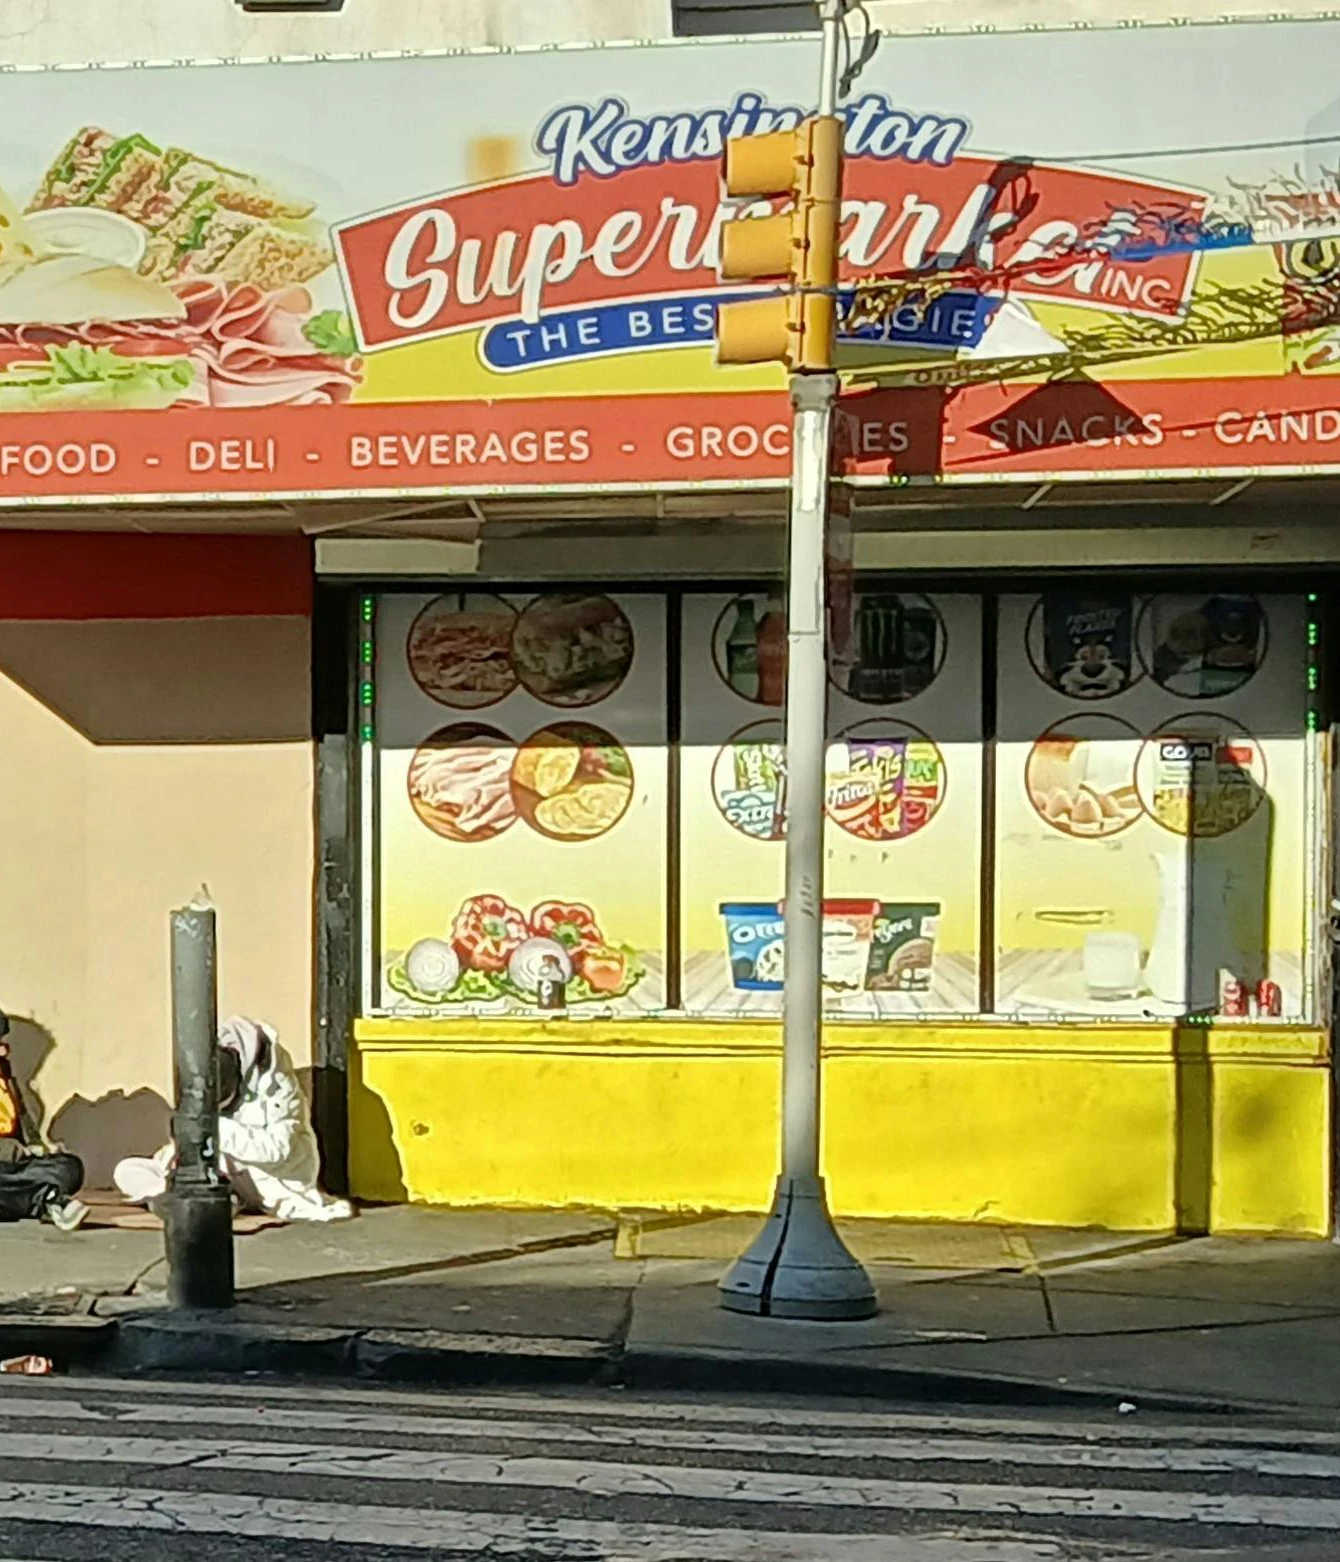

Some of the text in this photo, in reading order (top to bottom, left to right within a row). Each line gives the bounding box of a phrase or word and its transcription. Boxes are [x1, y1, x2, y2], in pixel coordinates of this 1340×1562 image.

[540, 95, 967, 183] Kensiton
[385, 184, 1171, 328] Superarket INC
[506, 317, 601, 357] THE
[628, 303, 715, 338] BES
[0, 443, 117, 475] FOOD
[189, 438, 277, 471] DELI
[350, 429, 591, 466] BEVERAGES
[666, 421, 909, 458] GROCES
[989, 412, 1163, 449] SNACKS
[1214, 410, 1340, 444] CAND
